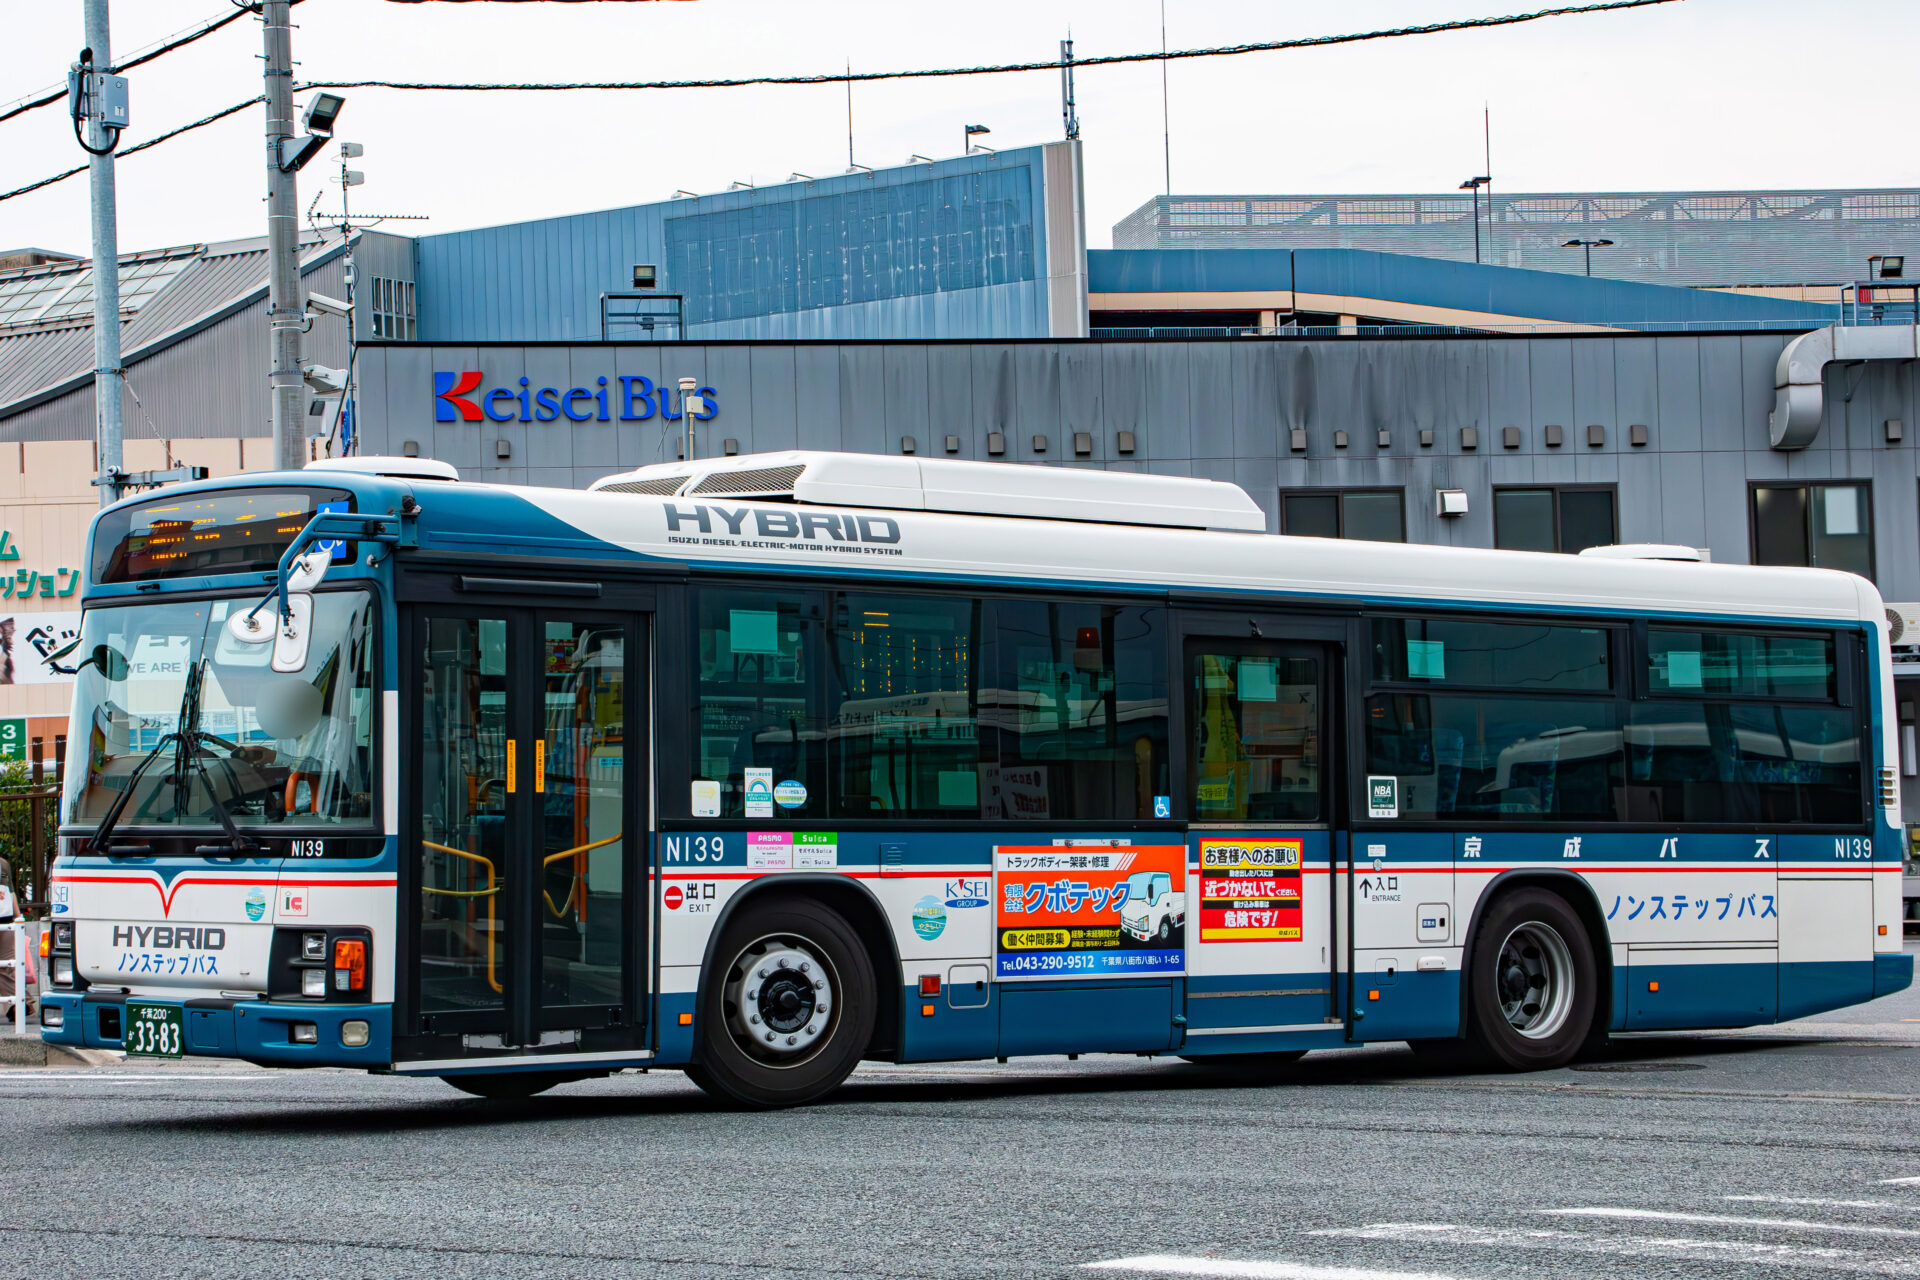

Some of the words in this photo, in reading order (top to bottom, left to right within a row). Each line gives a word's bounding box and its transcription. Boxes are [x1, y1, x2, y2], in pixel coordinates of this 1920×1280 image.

[434, 371, 609, 422] Keisei
[619, 375, 719, 421] Bus
[663, 503, 901, 544] HYBRID
[668, 536, 700, 545] ISUZU
[825, 545, 862, 554] HYBRID
[864, 547, 903, 556] SYSTEM
[150, 662, 182, 673] ARE
[1374, 785, 1392, 796] NBA
[758, 834, 782, 842] PASMO
[802, 834, 828, 842] Suica
[1007, 856, 1110, 868] トラックボディー架装・修理
[1205, 847, 1298, 865] お客様へのお願い
[685, 882, 716, 900] 出口
[1004, 884, 1024, 897] 有限
[1375, 876, 1398, 891] 入口
[956, 900, 978, 908] GROUP
[1025, 879, 1132, 914] クボテック
[689, 904, 712, 913] EXIT
[1004, 899, 1024, 912] 会社
[1607, 894, 1778, 921] ノンステップバス
[112, 925, 226, 951] HYBRID
[1007, 932, 1065, 947] 働く仲間募集
[118, 953, 219, 976] ノンステップバス
[1164, 955, 1180, 965] 1-65
